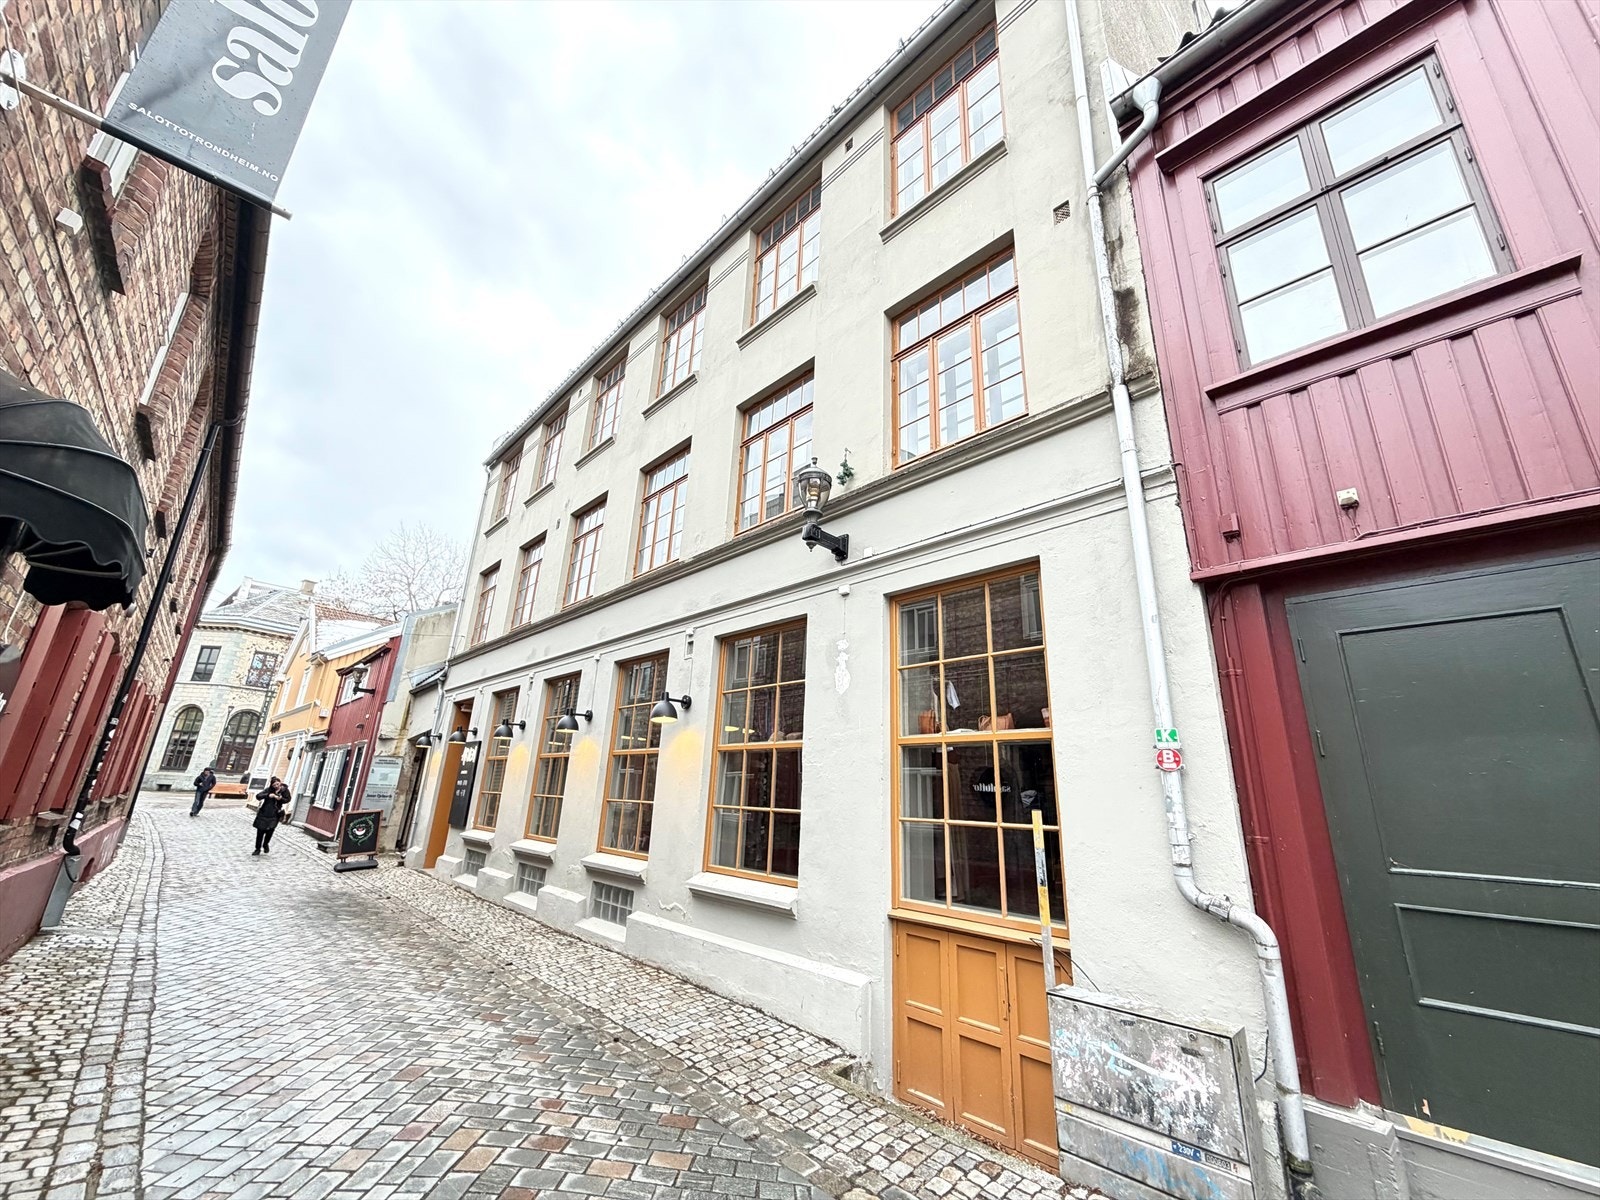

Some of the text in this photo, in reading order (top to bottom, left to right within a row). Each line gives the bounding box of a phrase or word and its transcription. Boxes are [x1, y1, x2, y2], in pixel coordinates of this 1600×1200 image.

[128, 102, 279, 183] SALOTTOTRONDHEIM.NO
[1161, 729, 1174, 742] K
[1162, 750, 1174, 762] B
